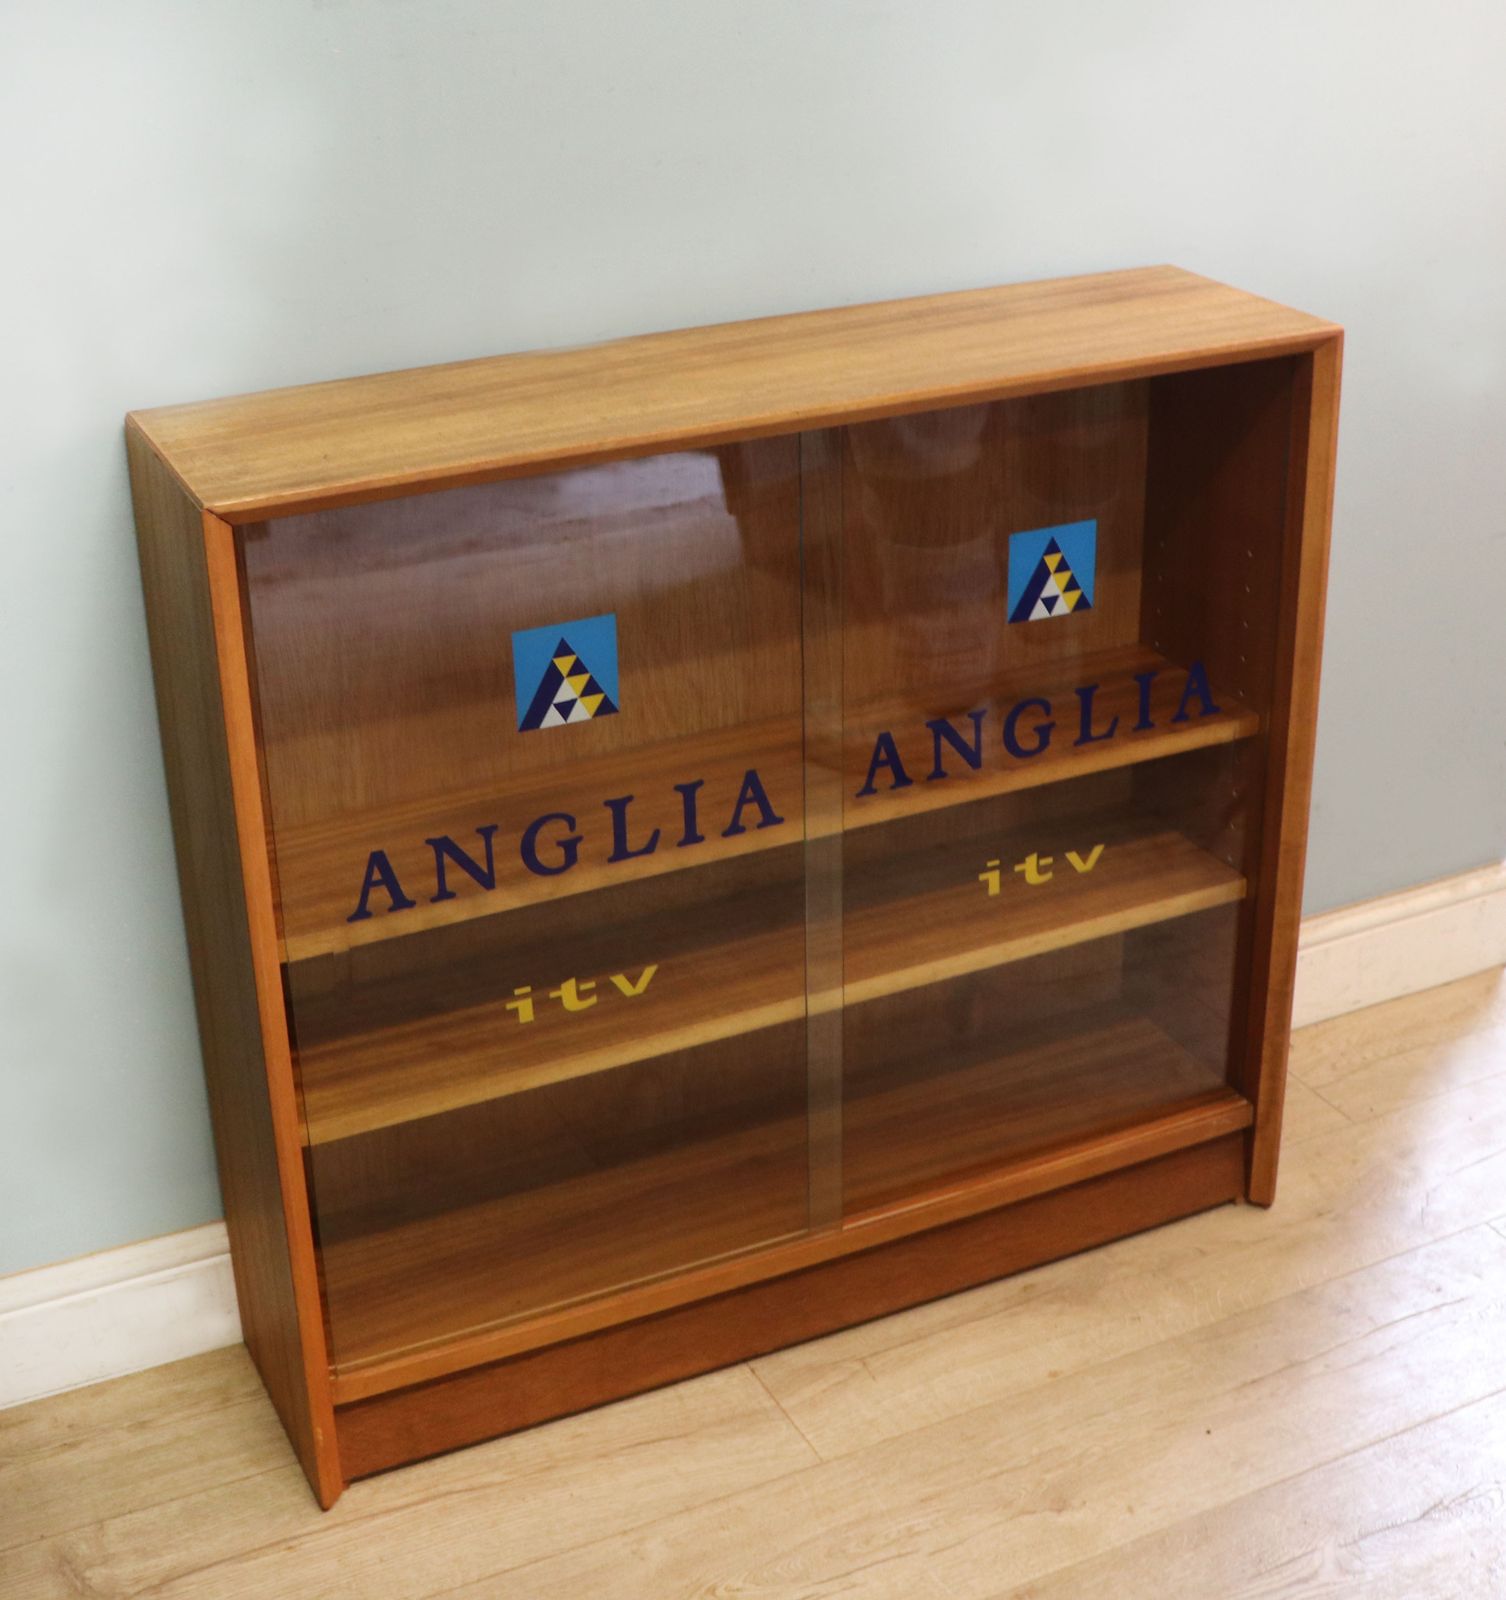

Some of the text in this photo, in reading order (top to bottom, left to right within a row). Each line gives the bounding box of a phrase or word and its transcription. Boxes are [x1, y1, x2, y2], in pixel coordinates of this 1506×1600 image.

[856, 660, 1221, 798] ANGLIA
[346, 769, 785, 923] ANGLIA
[977, 843, 1106, 898] itv
[505, 964, 659, 1024] itv
